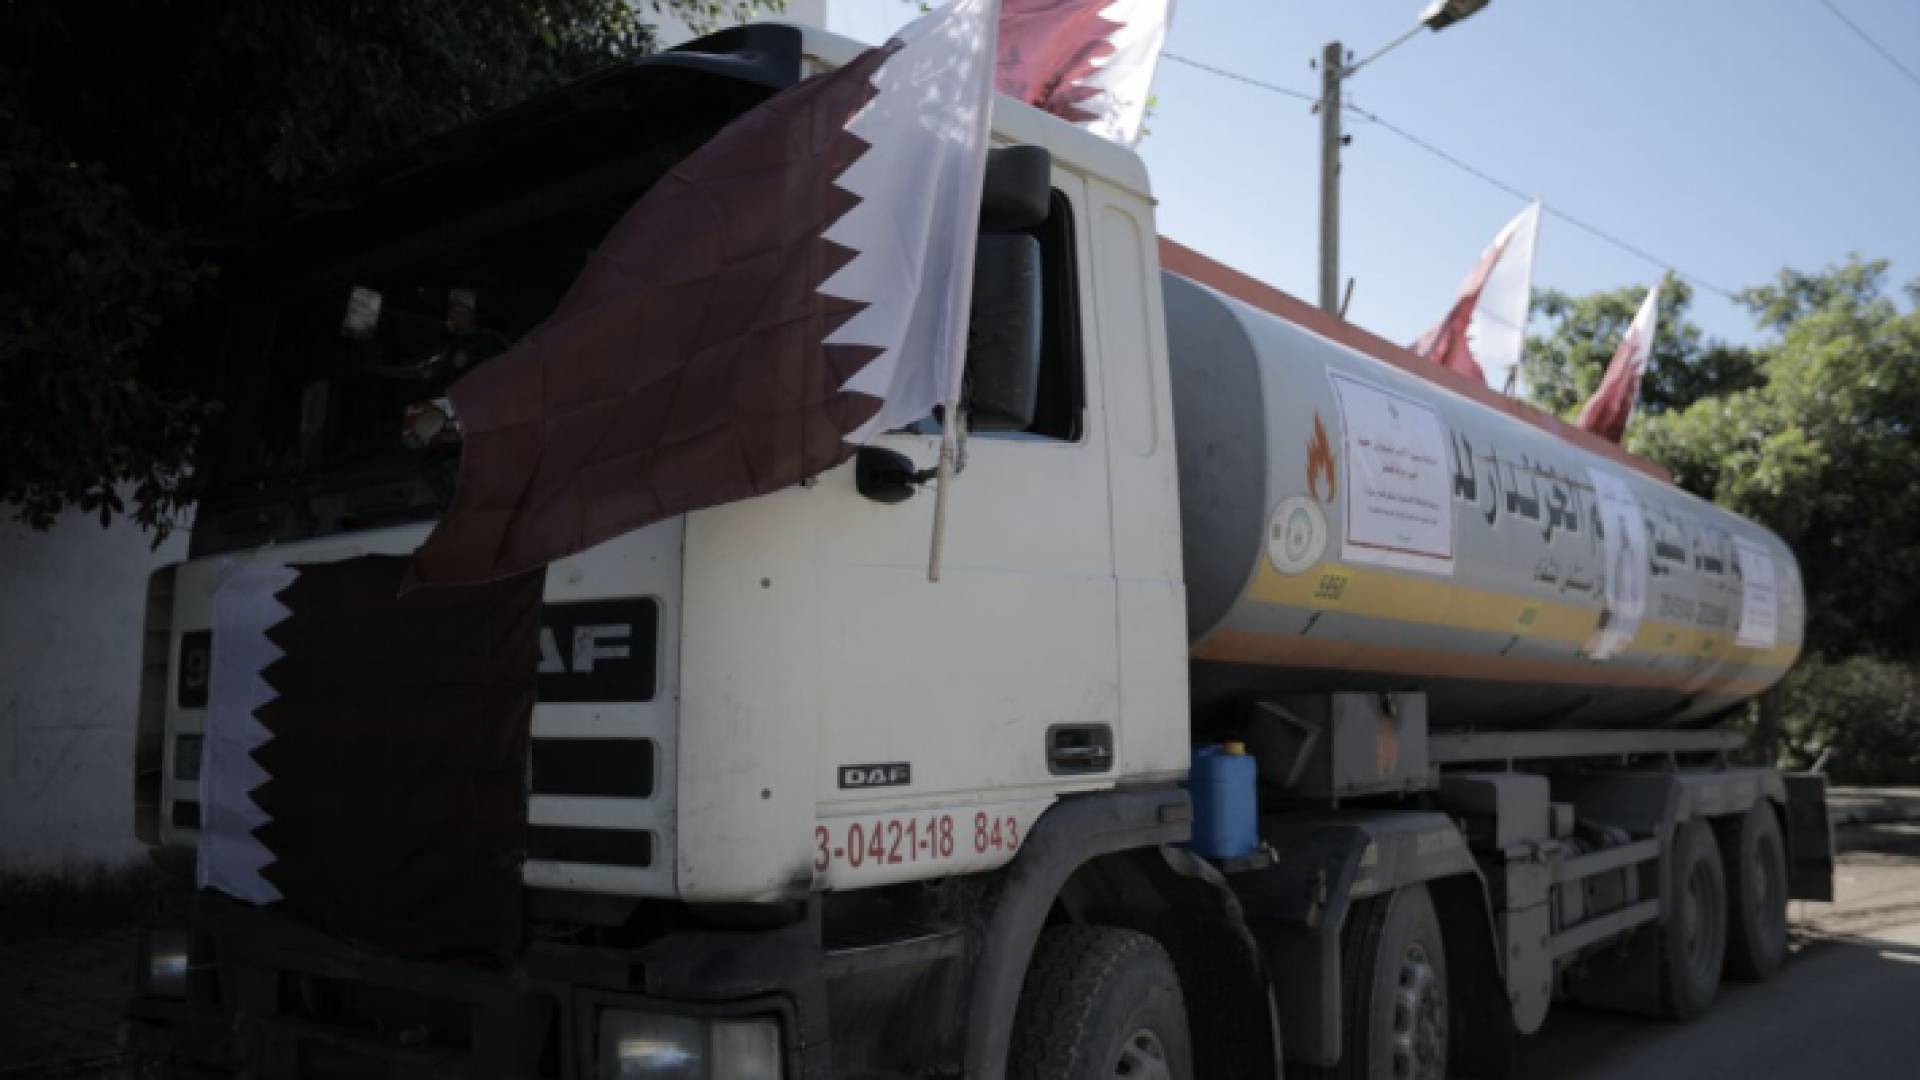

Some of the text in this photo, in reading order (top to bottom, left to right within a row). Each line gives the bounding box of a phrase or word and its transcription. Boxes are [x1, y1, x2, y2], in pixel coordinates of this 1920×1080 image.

[536, 623, 634, 673] AF
[844, 766, 908, 784] DAF
[815, 811, 1020, 873] 3-0421-18 843
